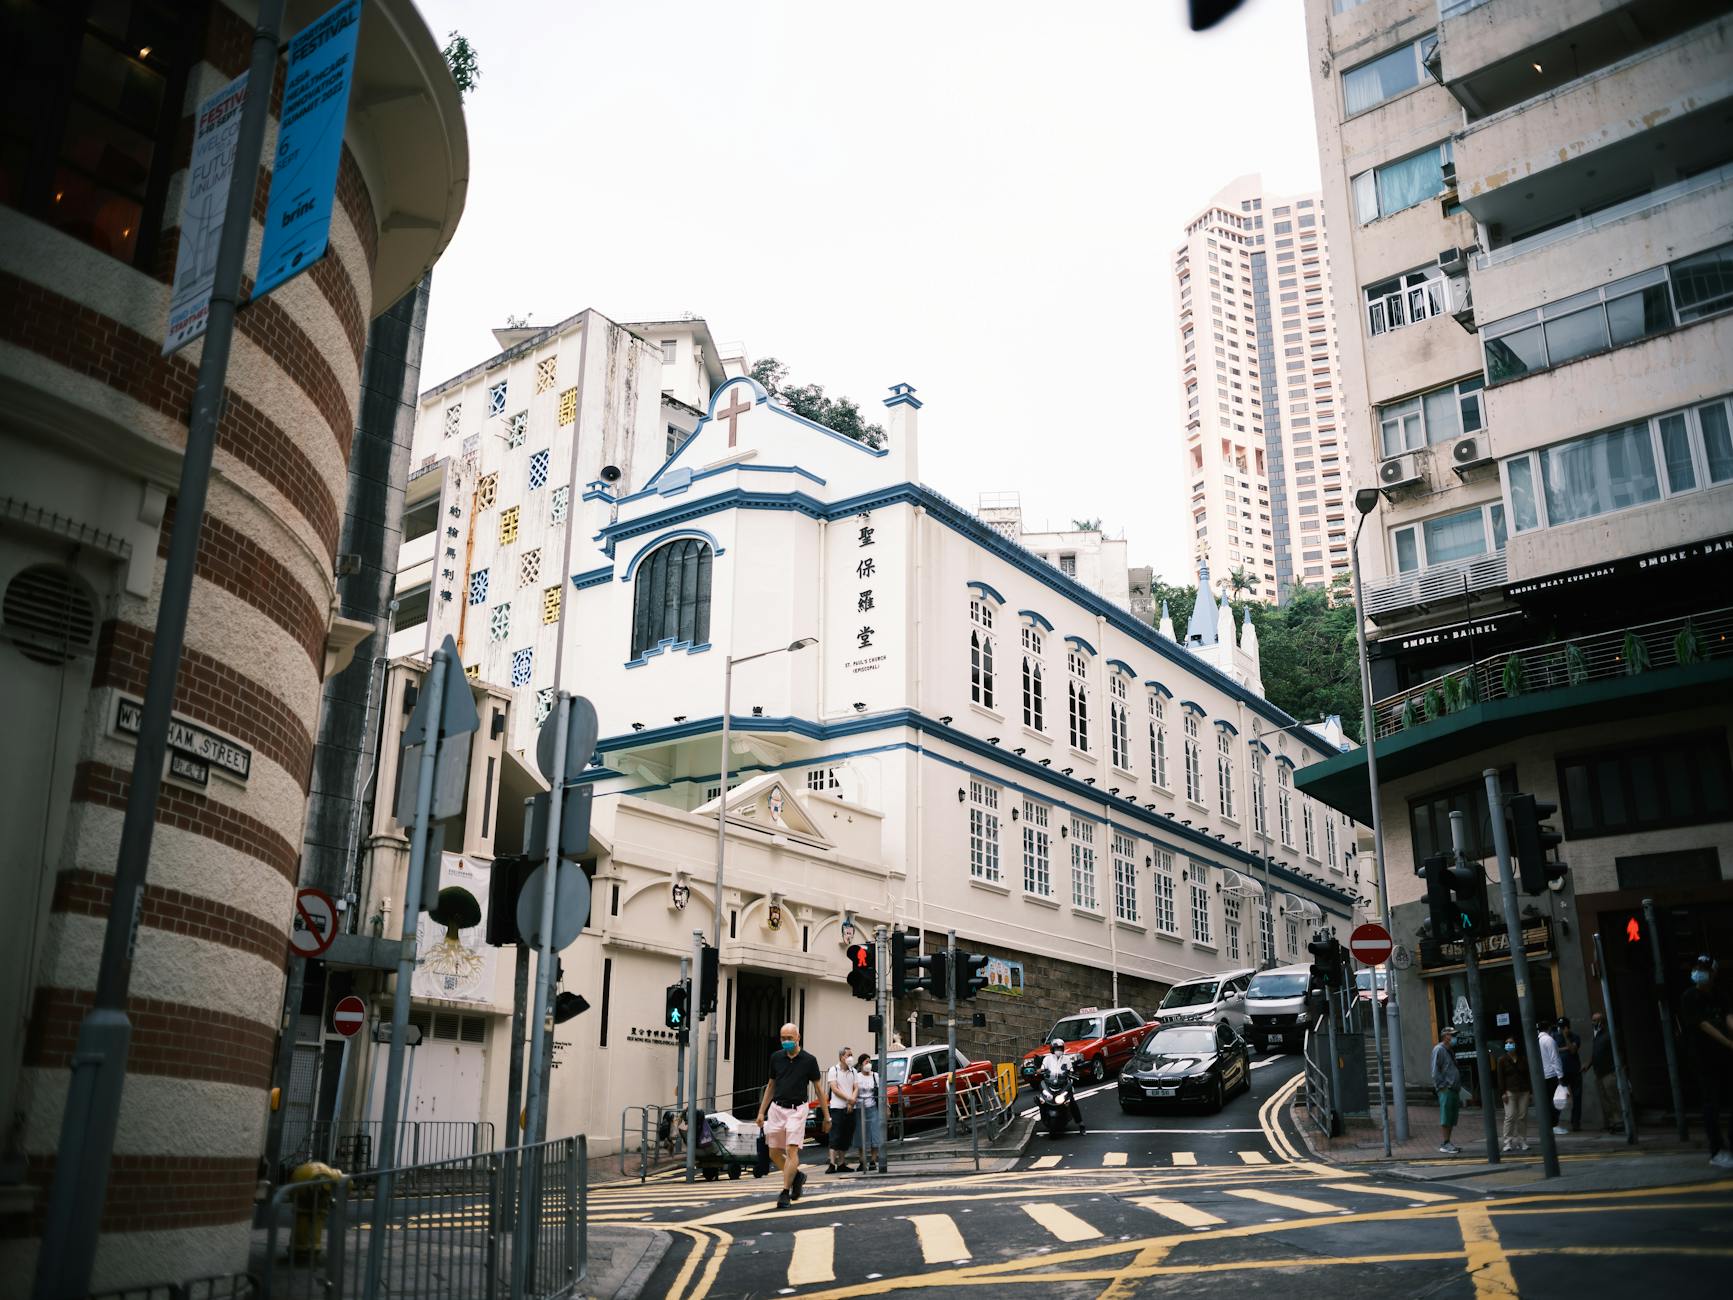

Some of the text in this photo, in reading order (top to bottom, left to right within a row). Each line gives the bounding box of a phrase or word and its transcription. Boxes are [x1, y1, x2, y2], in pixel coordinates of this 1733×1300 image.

[292, 11, 360, 66] FESTIVAL
[287, 52, 350, 101] HEALTHCARE
[287, 67, 345, 115] INNOVATION
[282, 96, 320, 130] SUMMIT
[197, 122, 240, 156] WELCO
[279, 136, 290, 156] 6
[193, 144, 240, 183] FUTUR
[275, 150, 299, 171] SEPT
[282, 197, 316, 228] brinc
[1639, 551, 1686, 568] SMOKE
[856, 526, 876, 649] 聖保羅堂
[1509, 567, 1615, 595] SMOKE MEAT EVERYDAY
[1403, 634, 1439, 649] SMOKE
[869, 655, 887, 663] CHURCH
[202, 738, 248, 771] STREET
